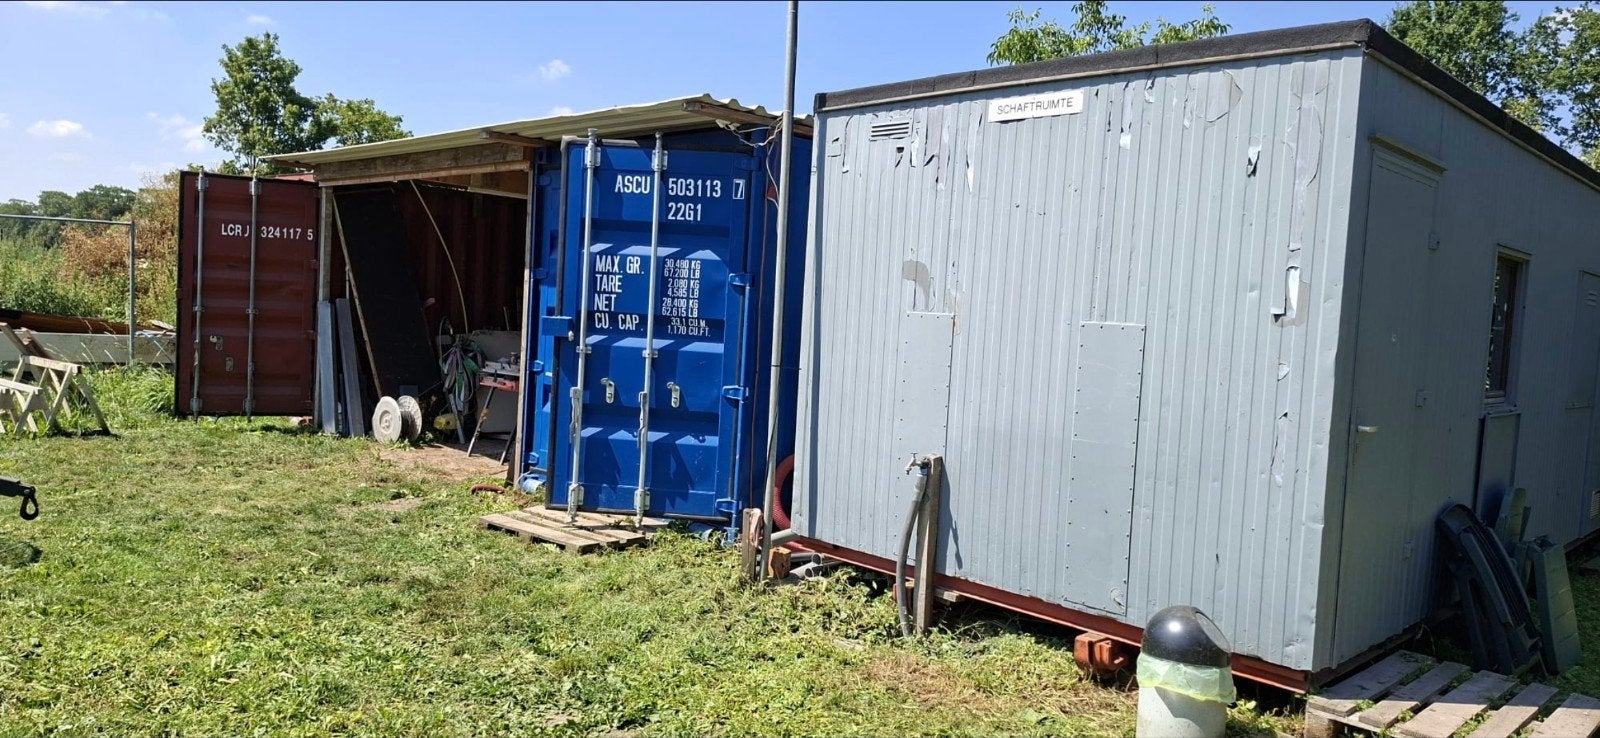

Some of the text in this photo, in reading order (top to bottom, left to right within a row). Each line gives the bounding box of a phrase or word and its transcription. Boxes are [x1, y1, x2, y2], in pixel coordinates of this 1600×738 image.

[997, 97, 1074, 115] SCHAFTRUIMTE
[615, 175, 745, 199] ASCU 503113 7
[667, 202, 702, 222] 22G1
[260, 226, 302, 240] 324117
[307, 228, 314, 241] 5
[595, 254, 645, 275] MAX. GR.
[664, 259, 701, 270] 30.480 KG
[664, 268, 700, 279] 67.200 LB
[595, 274, 623, 293] TARE
[667, 278, 700, 289] 2.080 KG
[667, 287, 699, 299] 4.585 LB
[594, 293, 617, 312] NET
[662, 297, 699, 309] 28.400 KG
[688, 308, 698, 318] LB
[594, 312, 644, 331] CU. CAP.
[667, 324, 687, 335] 1.170
